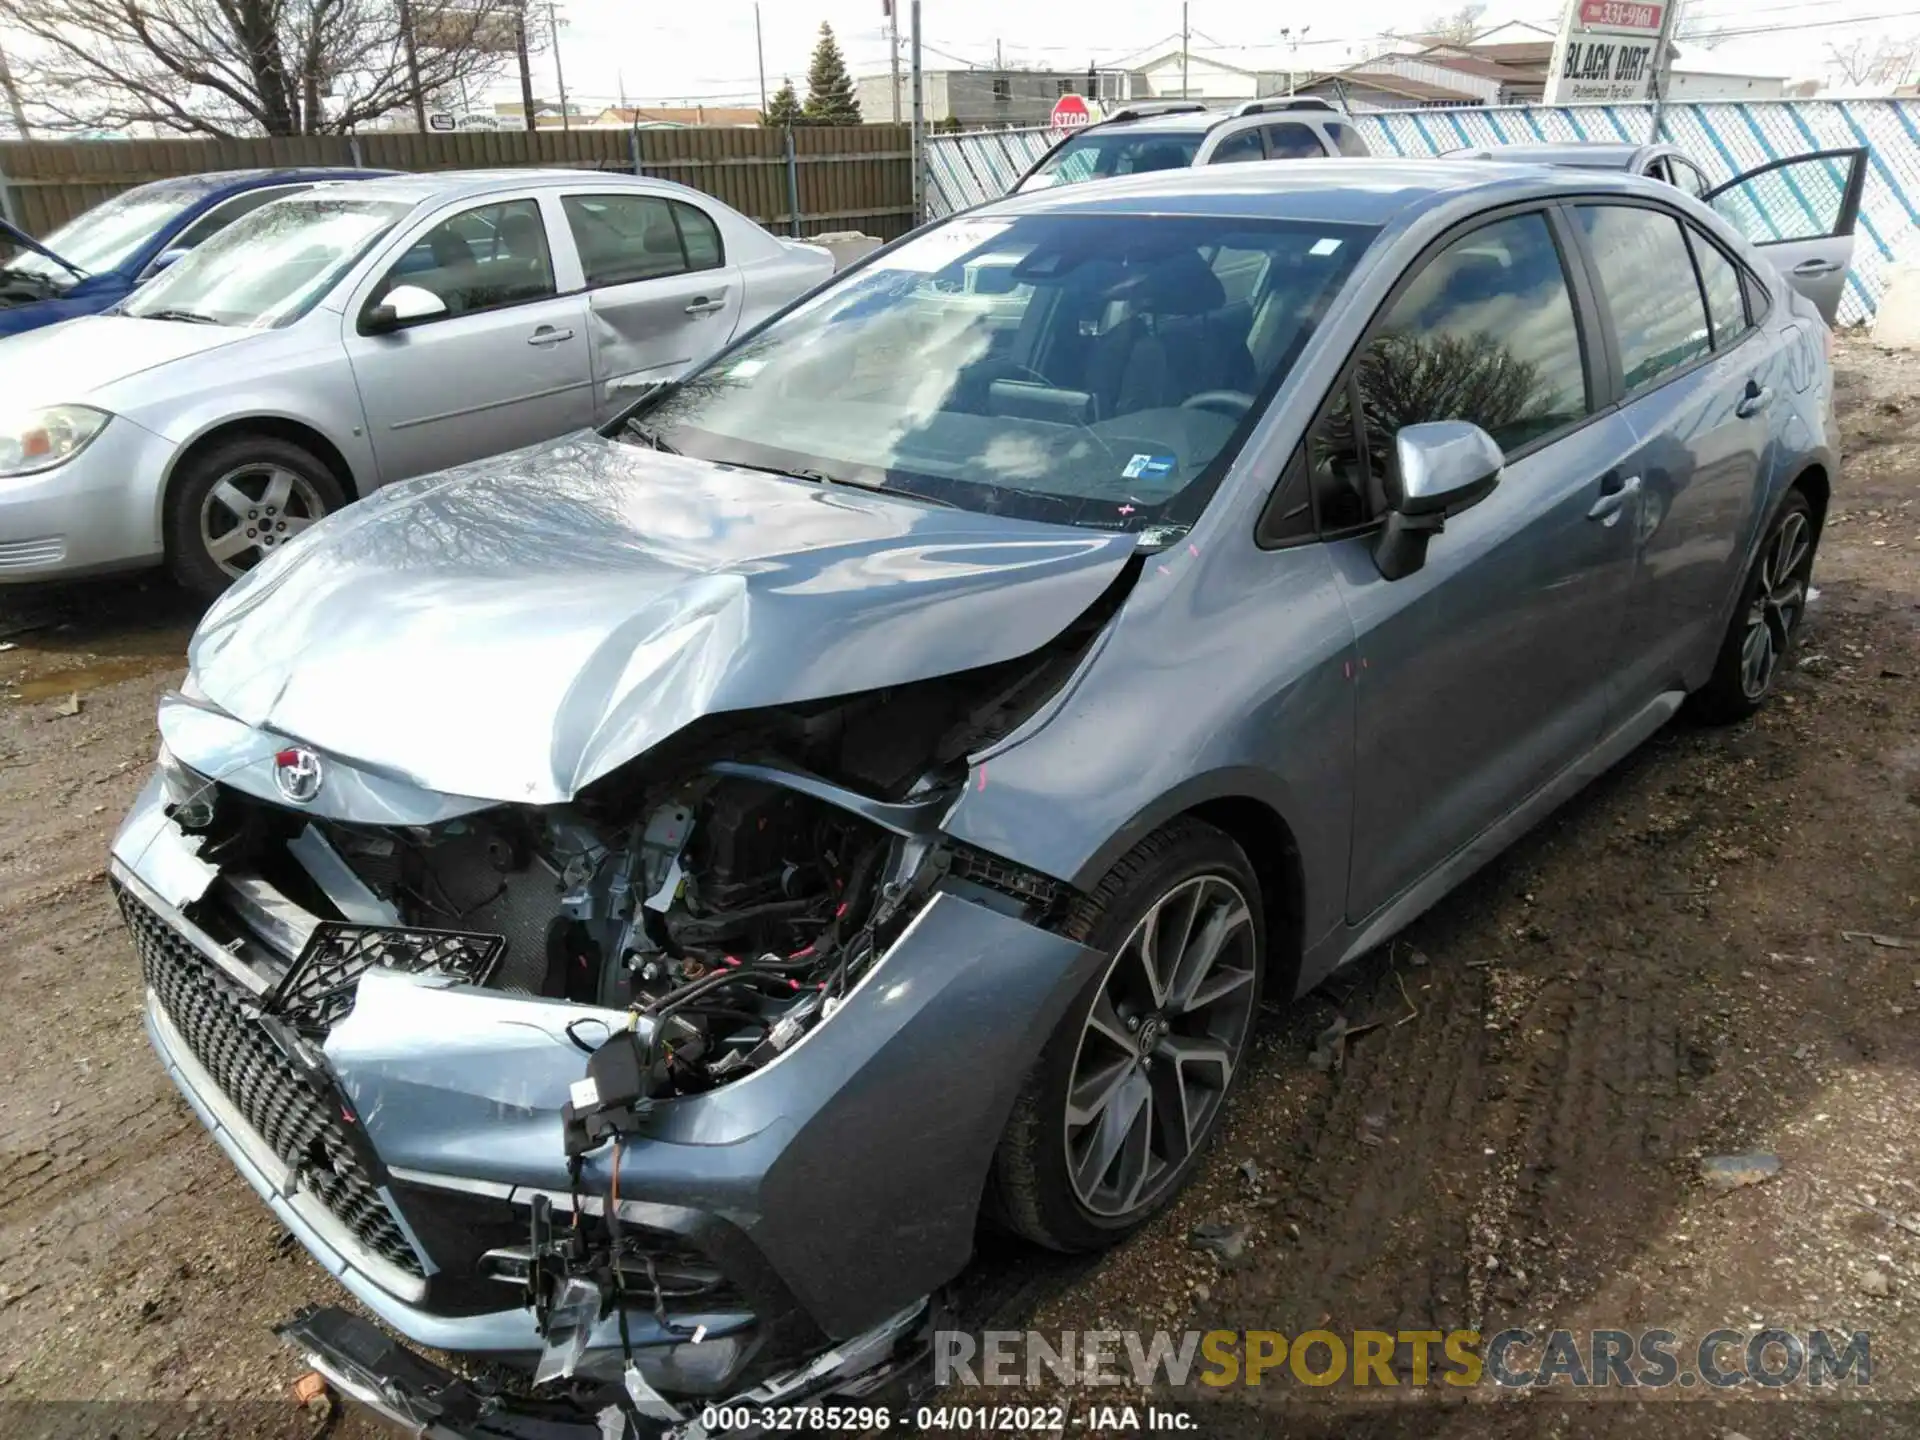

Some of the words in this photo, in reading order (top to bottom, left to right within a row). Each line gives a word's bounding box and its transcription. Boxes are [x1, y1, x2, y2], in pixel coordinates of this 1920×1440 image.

[1563, 42, 1615, 80] BLACK
[1614, 45, 1651, 81] DIRT
[1054, 111, 1088, 126] STOP
